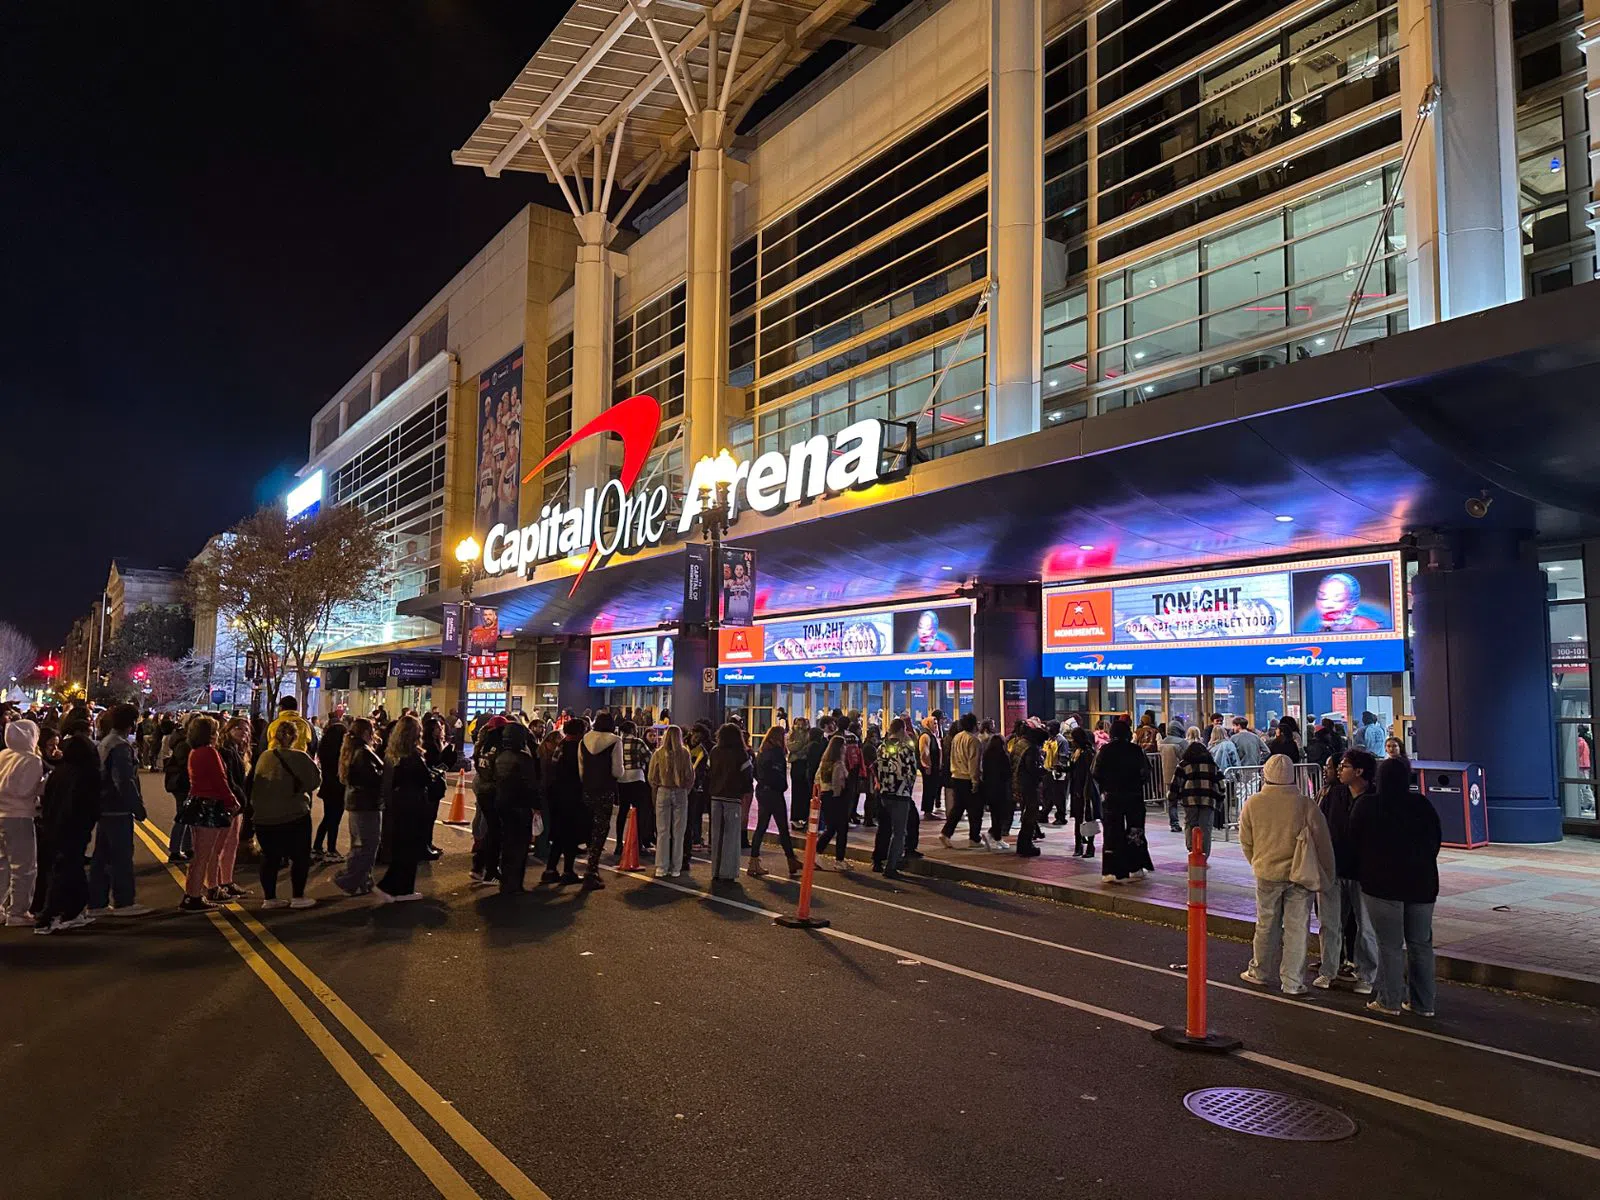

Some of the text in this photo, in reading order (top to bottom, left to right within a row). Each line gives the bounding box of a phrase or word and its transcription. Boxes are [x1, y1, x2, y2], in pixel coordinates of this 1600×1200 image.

[677, 418, 882, 533] Arena
[1198, 617, 1242, 630] SCARLET
[1246, 615, 1275, 627] TOUR
[1054, 628, 1105, 638] MONUMENTAL
[1107, 662, 1133, 670] Arena
[1326, 656, 1364, 666] Arena
